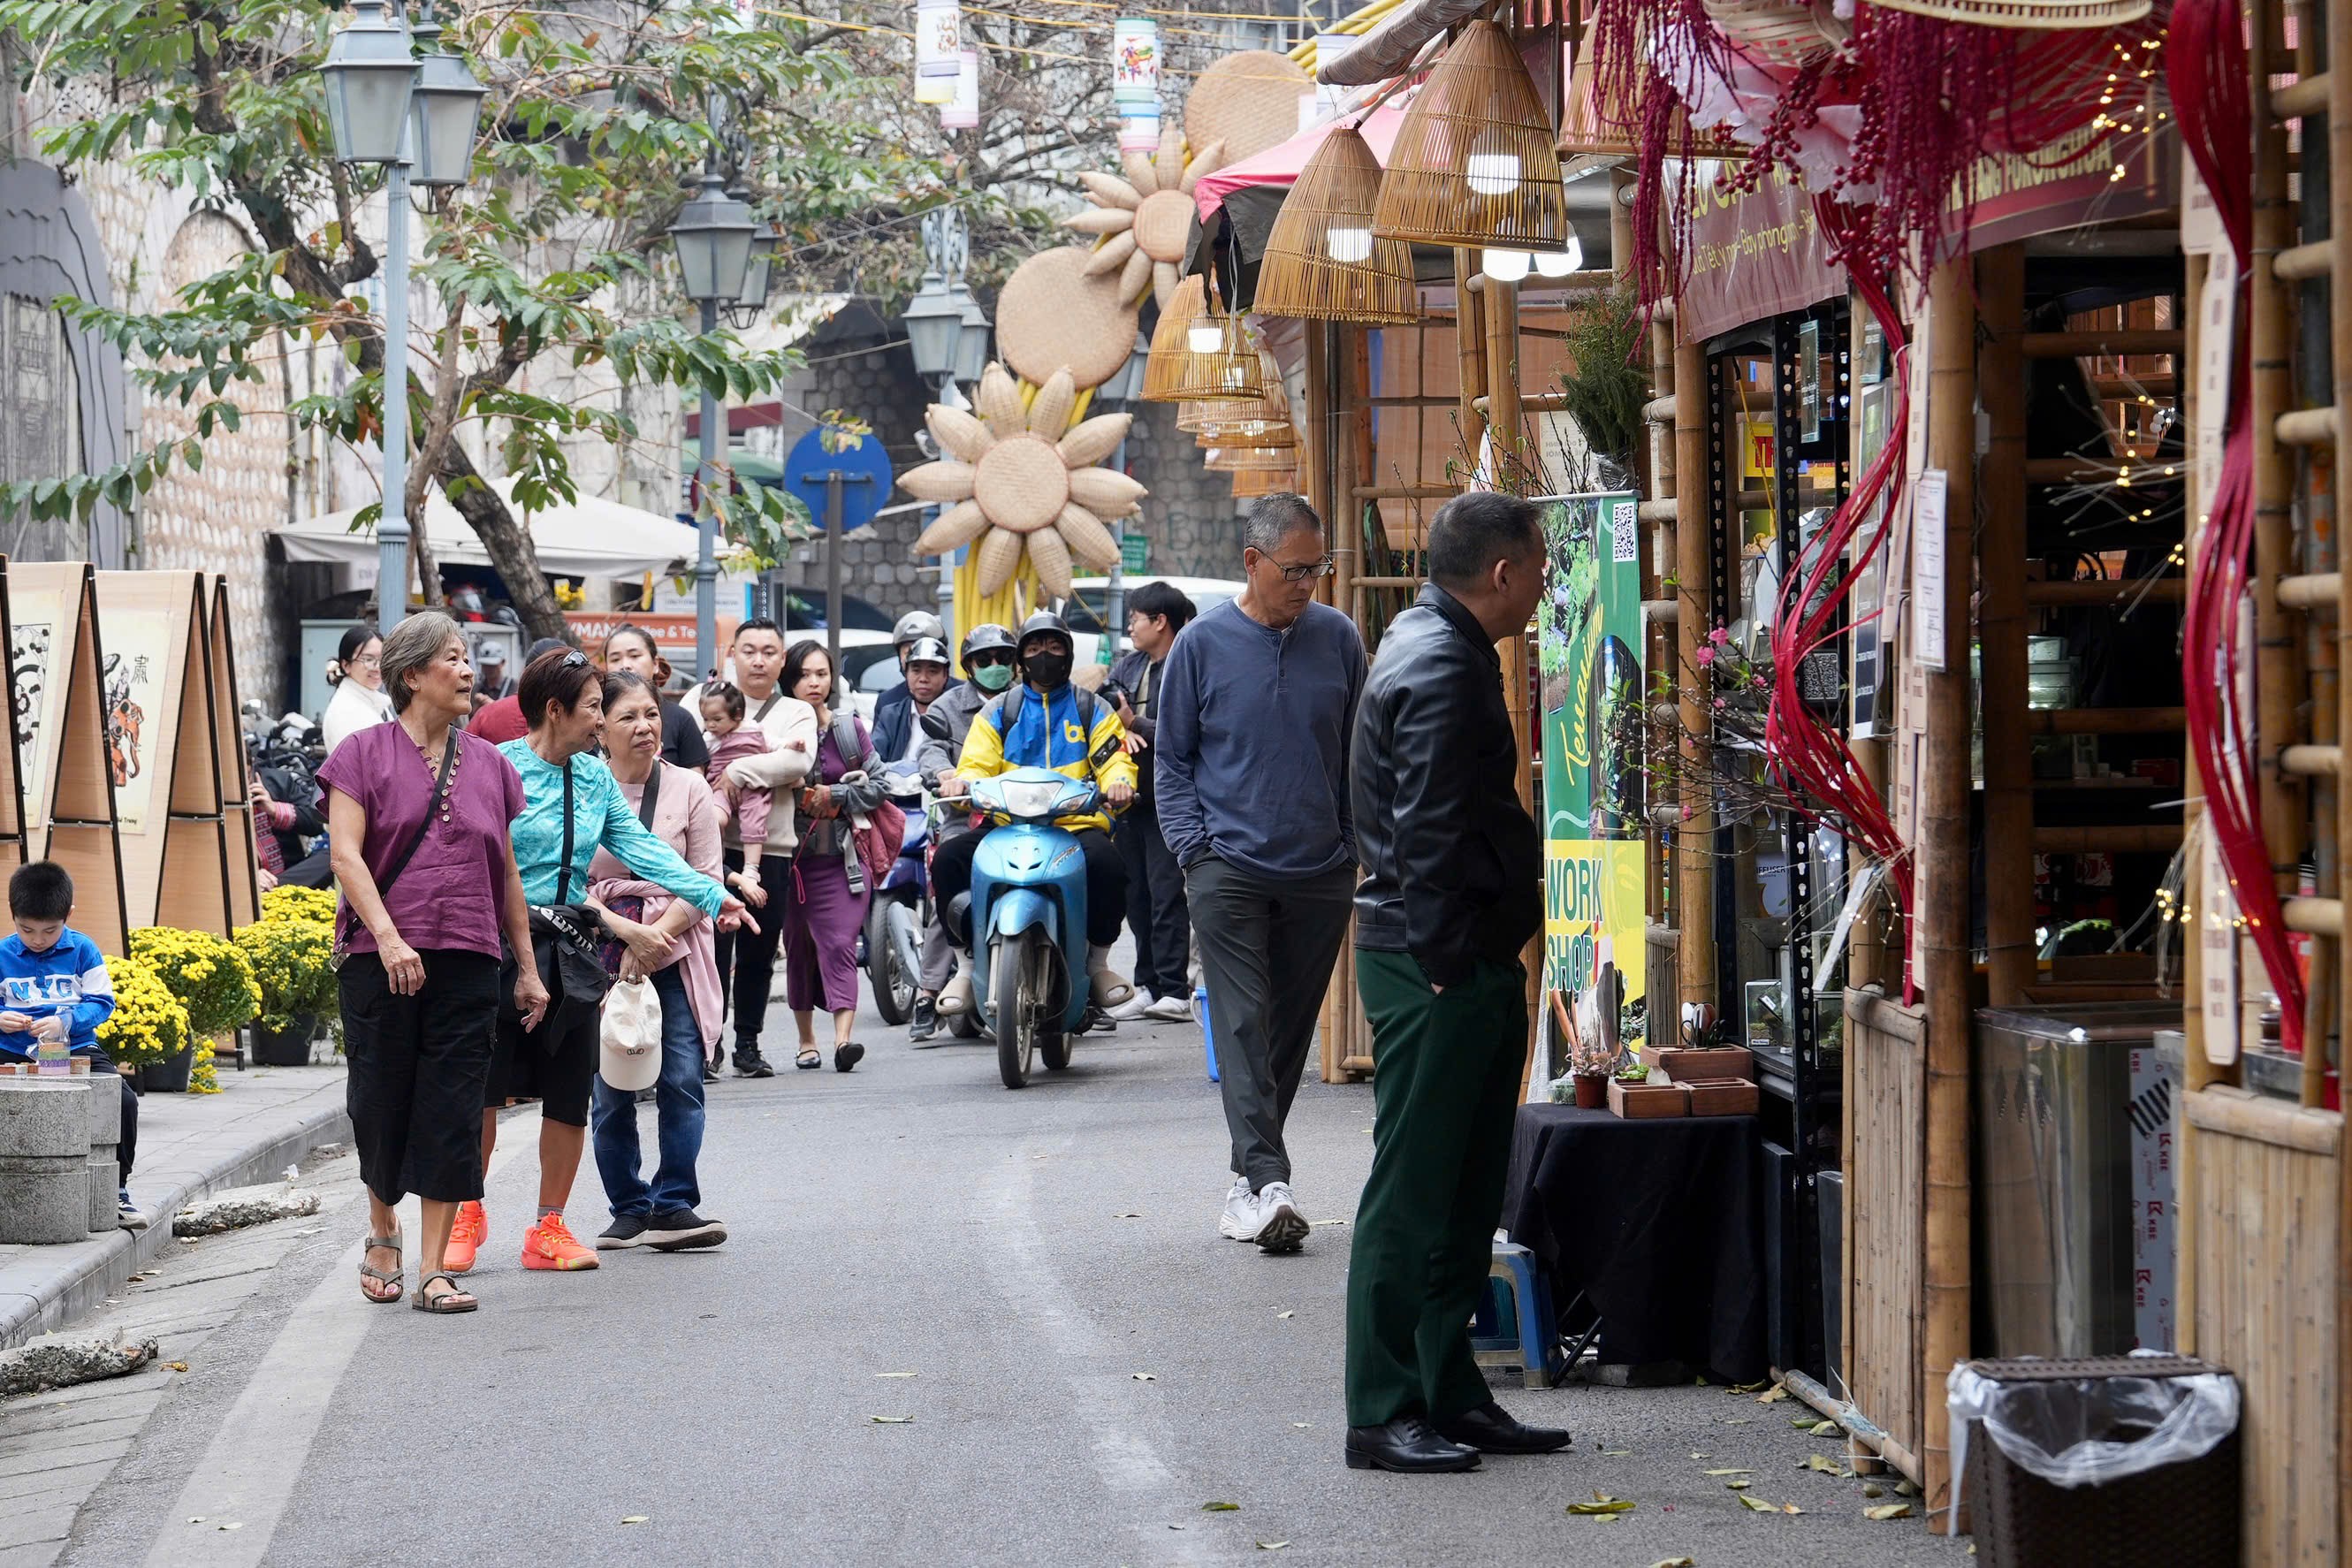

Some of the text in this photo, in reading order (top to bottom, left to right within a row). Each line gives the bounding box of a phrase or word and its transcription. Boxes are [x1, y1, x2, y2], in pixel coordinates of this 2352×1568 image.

[666, 626, 678, 638] &
[680, 626, 696, 637] Te
[1546, 858, 1604, 922] WORK
[1546, 933, 1595, 992] SHOP
[9, 978, 72, 1001] NYC
